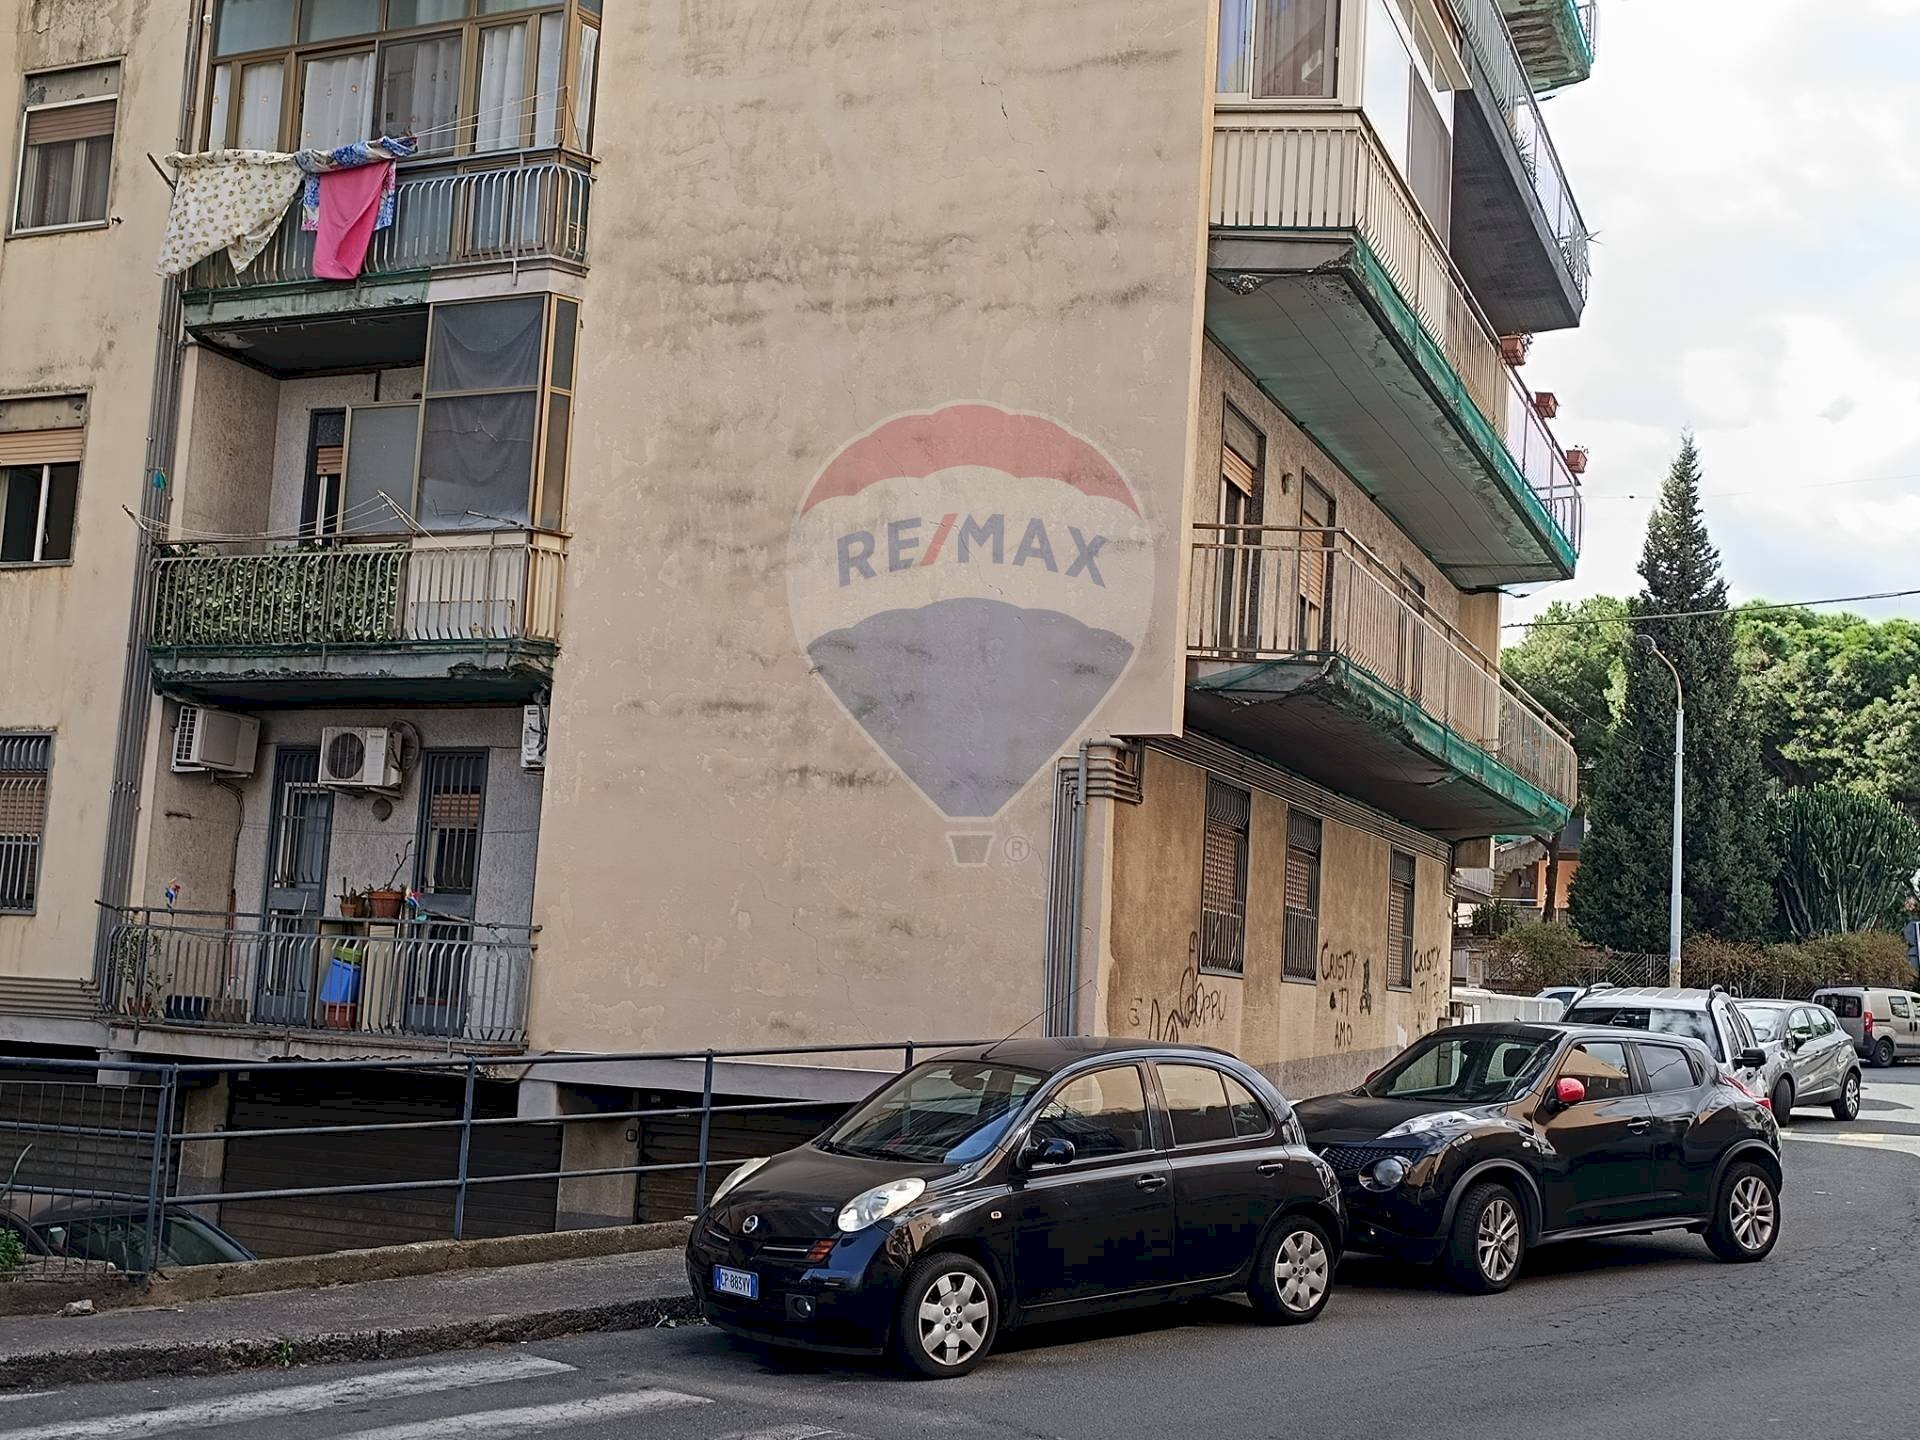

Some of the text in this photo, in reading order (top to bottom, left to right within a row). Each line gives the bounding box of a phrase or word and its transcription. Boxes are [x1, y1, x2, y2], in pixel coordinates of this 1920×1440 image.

[1320, 940, 1357, 981] CRISTY
[1413, 945, 1441, 973] CRISTY
[1334, 1019, 1353, 1049] AMO
